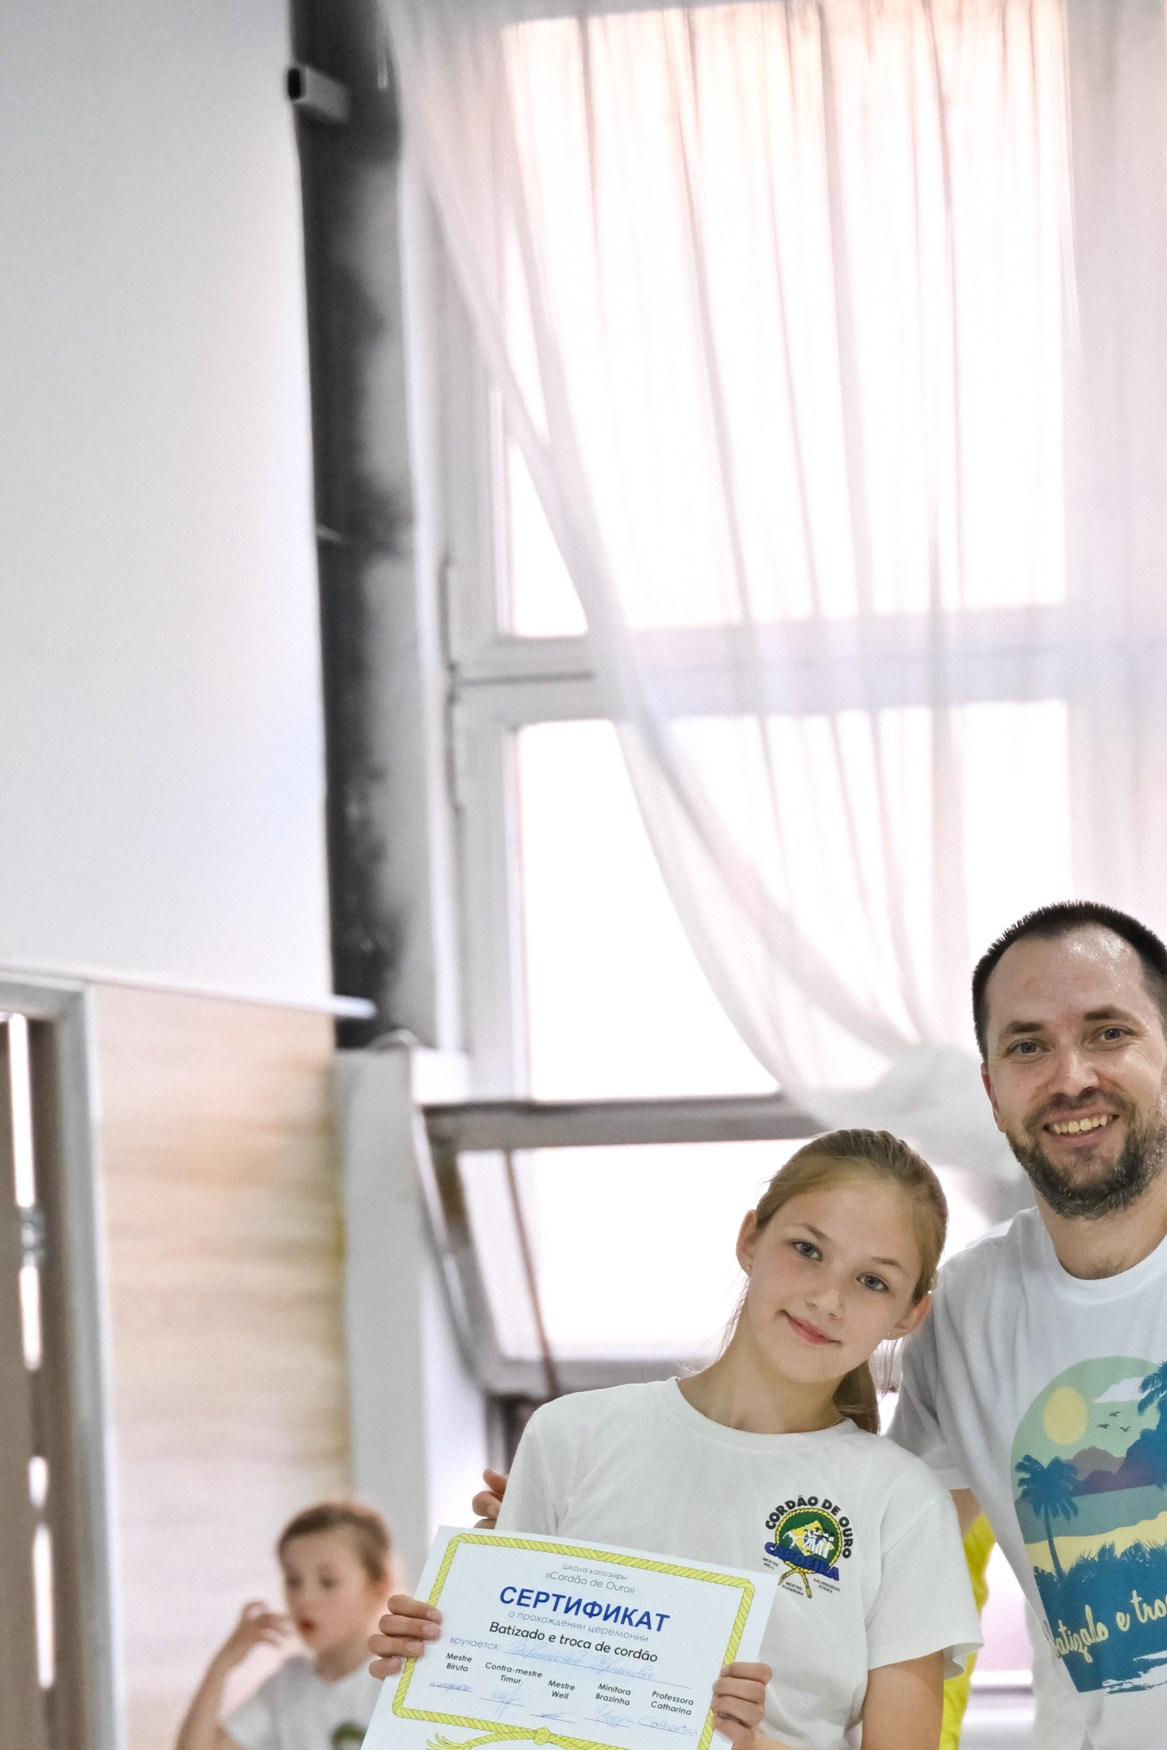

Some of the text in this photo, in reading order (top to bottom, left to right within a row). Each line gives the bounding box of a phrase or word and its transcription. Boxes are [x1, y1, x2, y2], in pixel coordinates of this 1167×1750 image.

[766, 1495, 853, 1559] CORDÃO DE OURO
[562, 1563, 587, 1574] Школа
[545, 1571, 635, 1594] «Cordão de Ouro»
[500, 1586, 670, 1632] СЕРТИФИКАТ
[517, 1611, 586, 1631] прохождении
[588, 1624, 649, 1643] церемонии
[1116, 1611, 1131, 1632] e
[449, 1637, 501, 1651] вручается:
[489, 1621, 545, 1641] Batizado
[548, 1632, 556, 1643] e
[559, 1634, 591, 1650] troca
[594, 1641, 611, 1653] de
[614, 1645, 658, 1663] cordão
[445, 1652, 473, 1663] Mestre
[446, 1662, 469, 1672] Biruta
[485, 1662, 543, 1678] Contra-mestre
[500, 1674, 522, 1685] Timur
[548, 1680, 576, 1691] Mestre
[551, 1690, 569, 1700] Well
[598, 1683, 631, 1696] Minitora
[595, 1692, 631, 1706] Brazinha
[651, 1690, 694, 1706] Professora
[650, 1701, 692, 1716] Catharina
